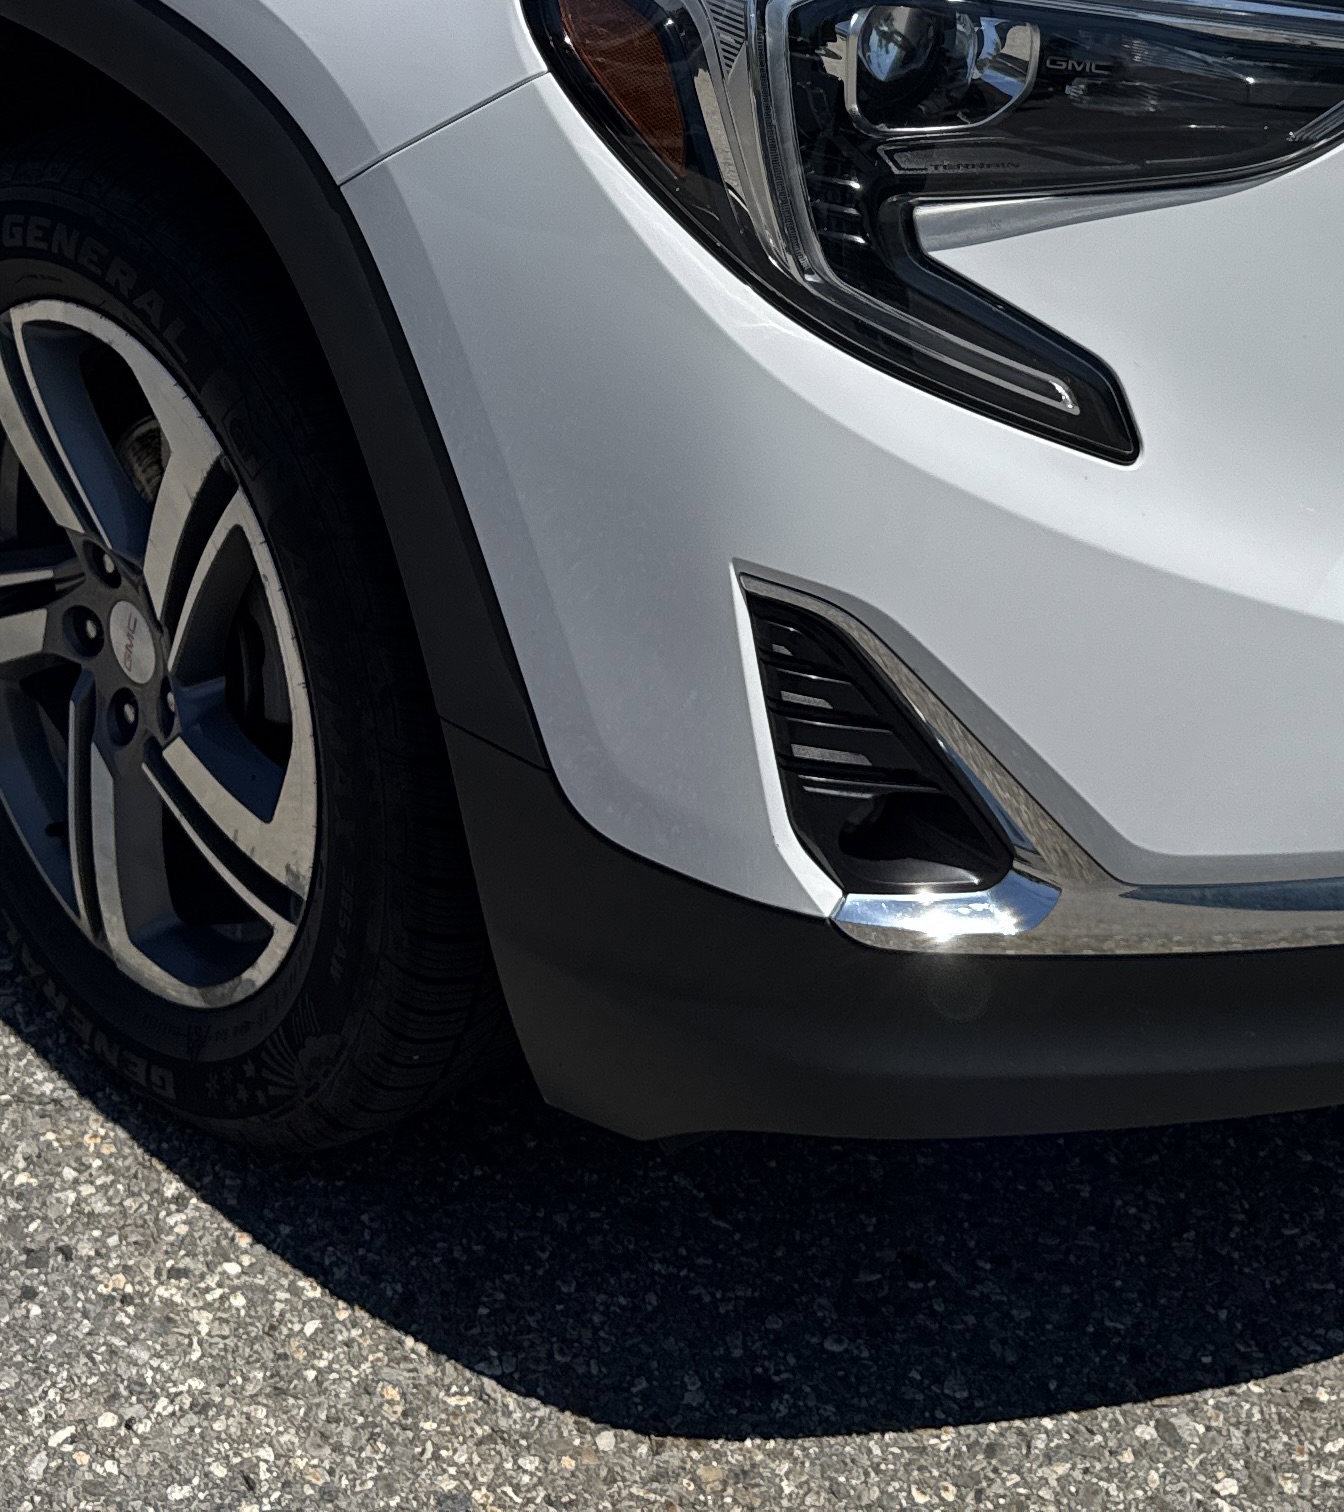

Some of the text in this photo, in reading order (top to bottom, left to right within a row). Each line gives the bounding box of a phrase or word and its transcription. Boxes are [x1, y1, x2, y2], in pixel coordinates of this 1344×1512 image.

[1046, 55, 1114, 75] GMC
[2, 214, 190, 364] GENERAL
[123, 612, 138, 673] GMC
